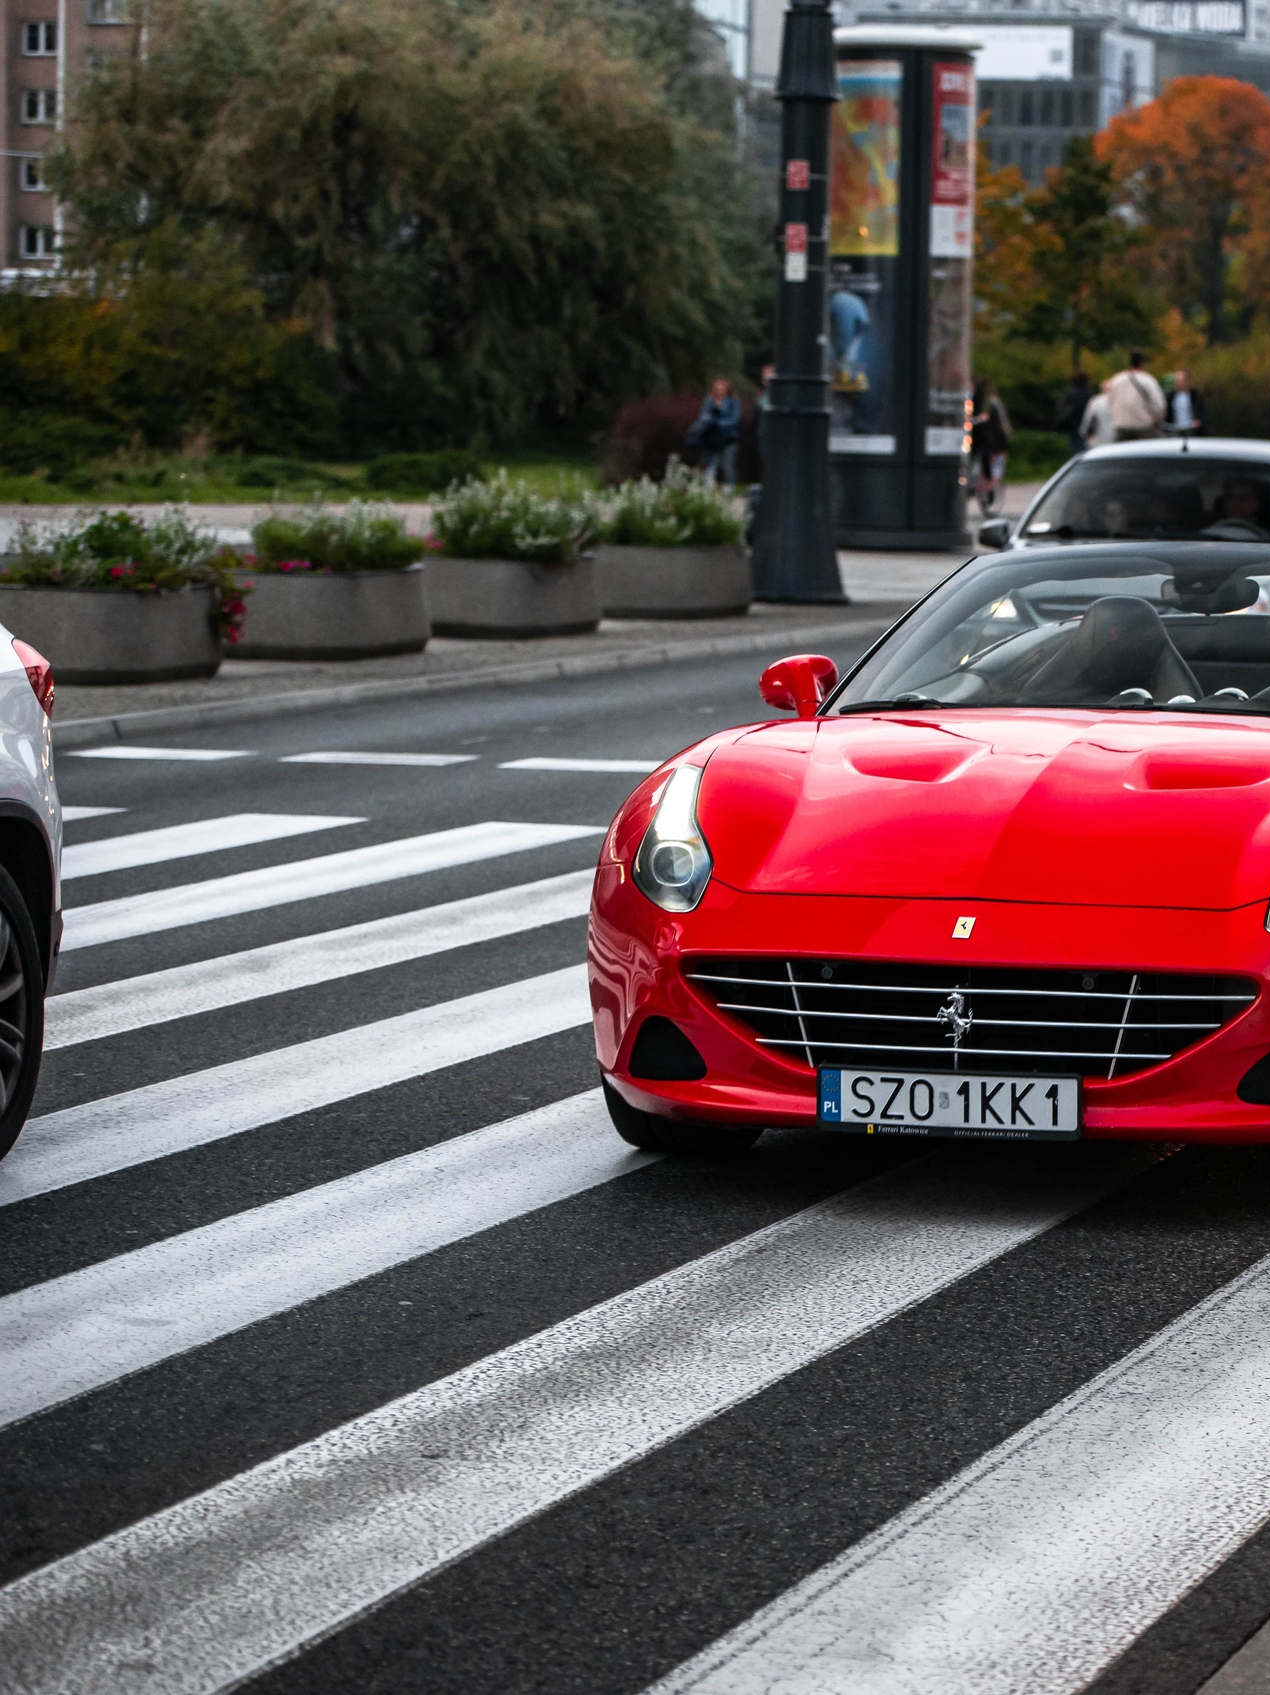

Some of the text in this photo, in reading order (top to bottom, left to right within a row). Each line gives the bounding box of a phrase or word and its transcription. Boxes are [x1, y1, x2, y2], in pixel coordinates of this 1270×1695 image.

[823, 1100, 839, 1114] PL
[851, 1075, 1059, 1126] SZO 1KK1
[877, 1125, 929, 1135] Ferrari Katowice
